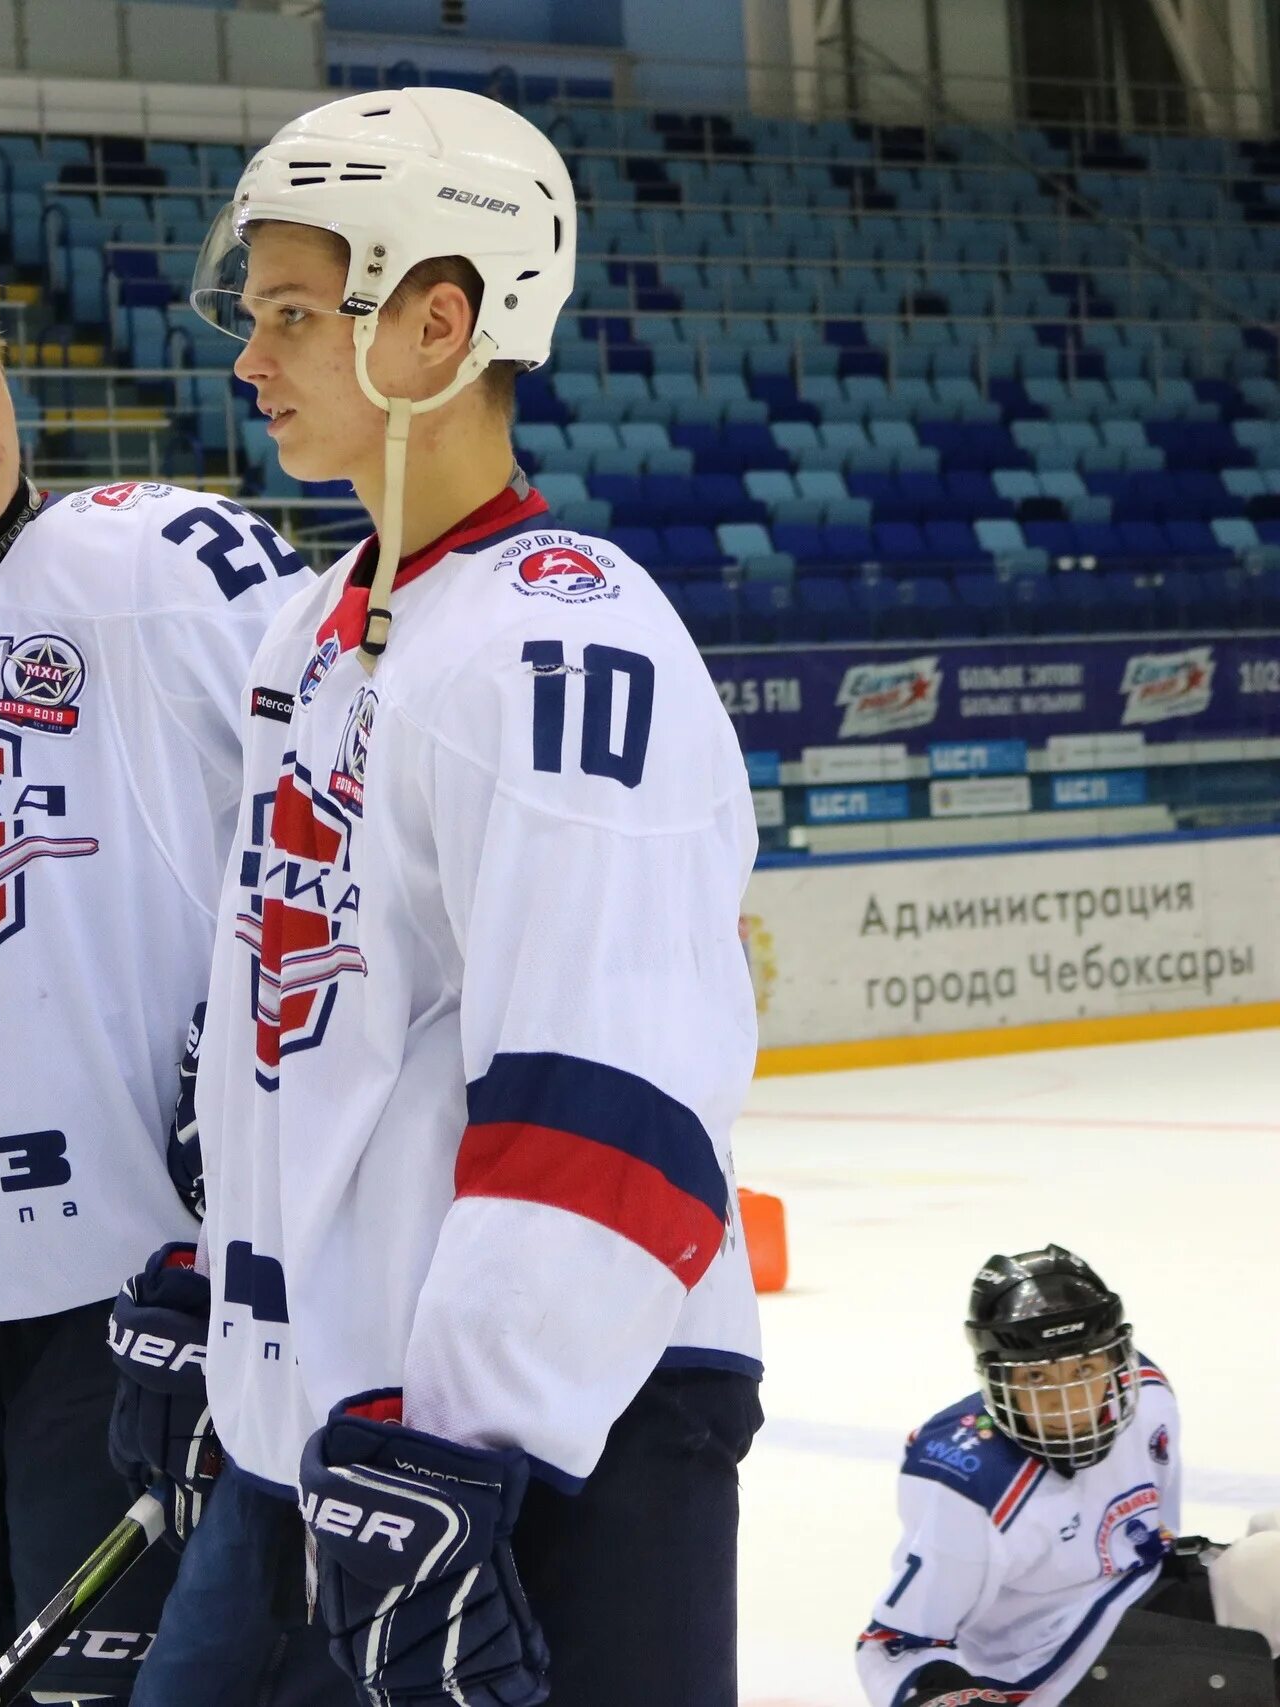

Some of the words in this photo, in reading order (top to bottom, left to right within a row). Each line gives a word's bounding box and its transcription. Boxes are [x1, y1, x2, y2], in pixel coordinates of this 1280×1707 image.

[26, 663, 63, 681] МХЛ
[34, 708, 63, 722] 2019
[521, 640, 655, 789] 10
[859, 881, 1196, 938] Администрация
[865, 966, 1018, 1022] города
[1027, 943, 1256, 996] Чебоксары
